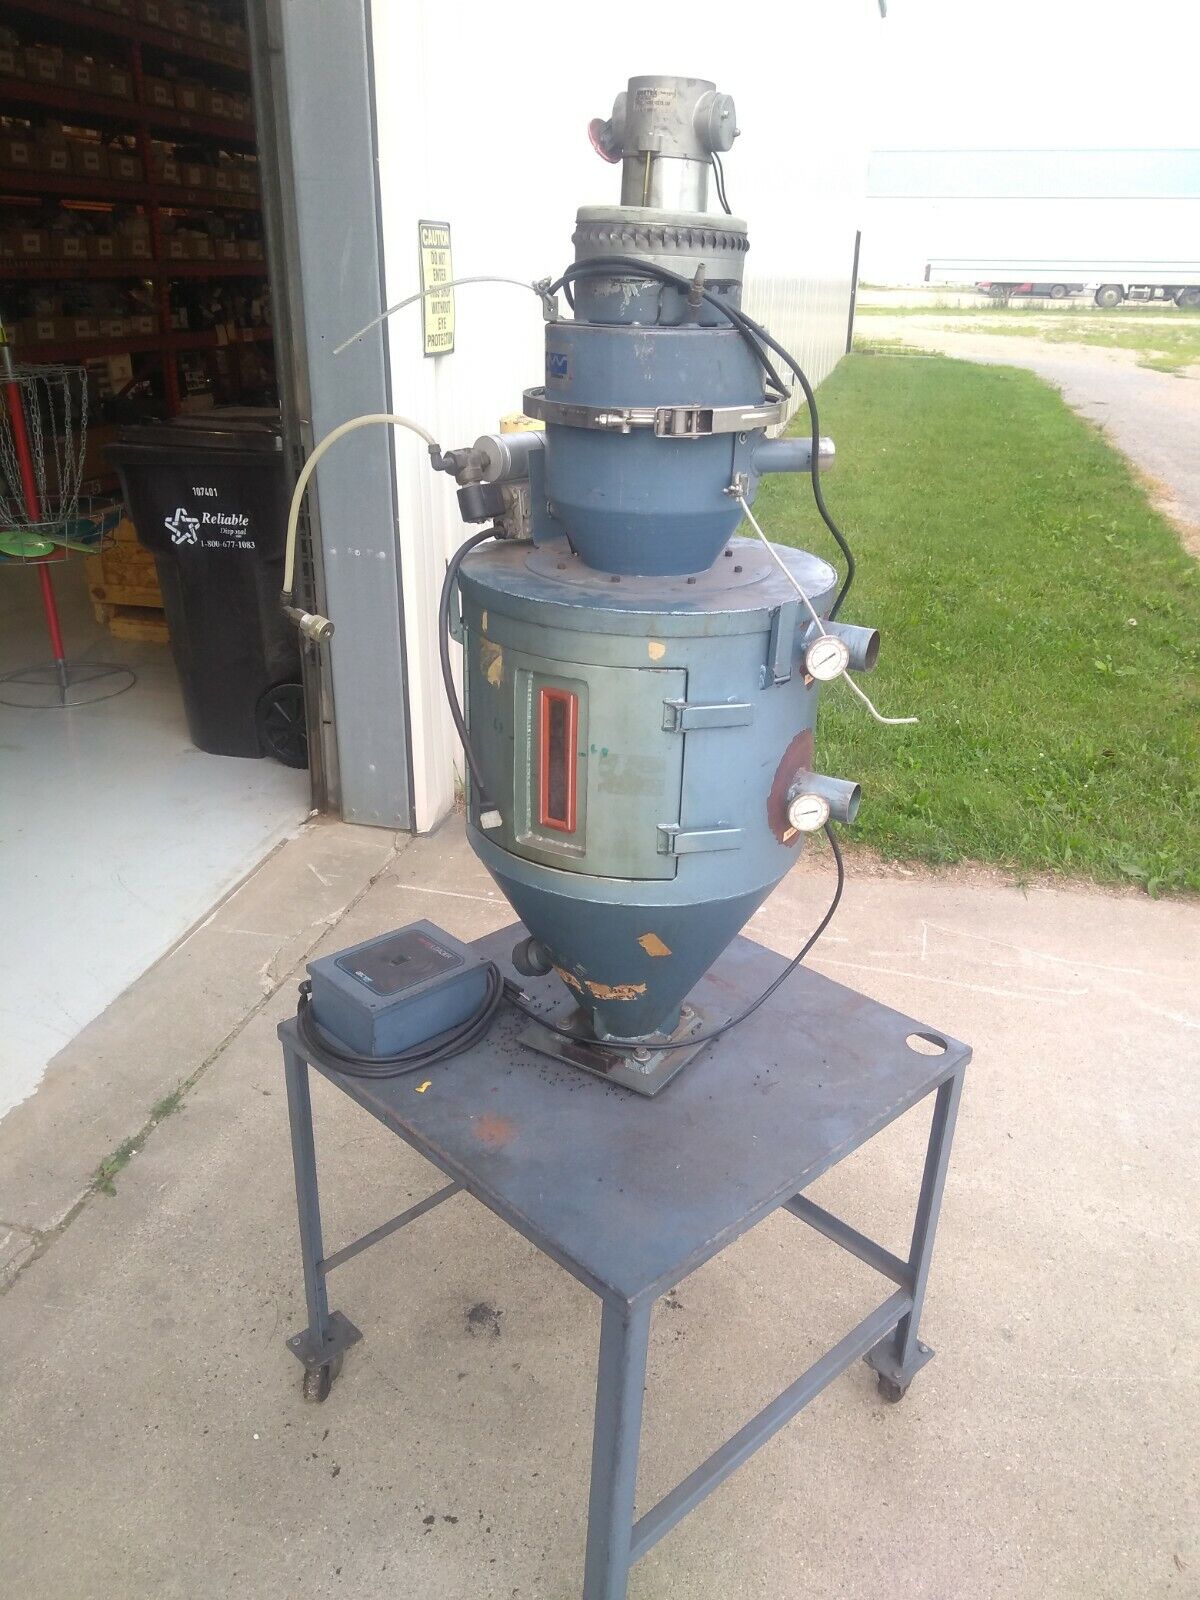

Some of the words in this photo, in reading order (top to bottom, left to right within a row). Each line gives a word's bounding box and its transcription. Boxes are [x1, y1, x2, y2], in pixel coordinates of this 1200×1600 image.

[423, 229, 449, 246] CAUTION
[431, 251, 437, 265] DO
[438, 317, 446, 330] EYE
[192, 486, 218, 497] 107401
[201, 511, 250, 527] Reliable
[200, 540, 256, 550] 1-800-677-1083
